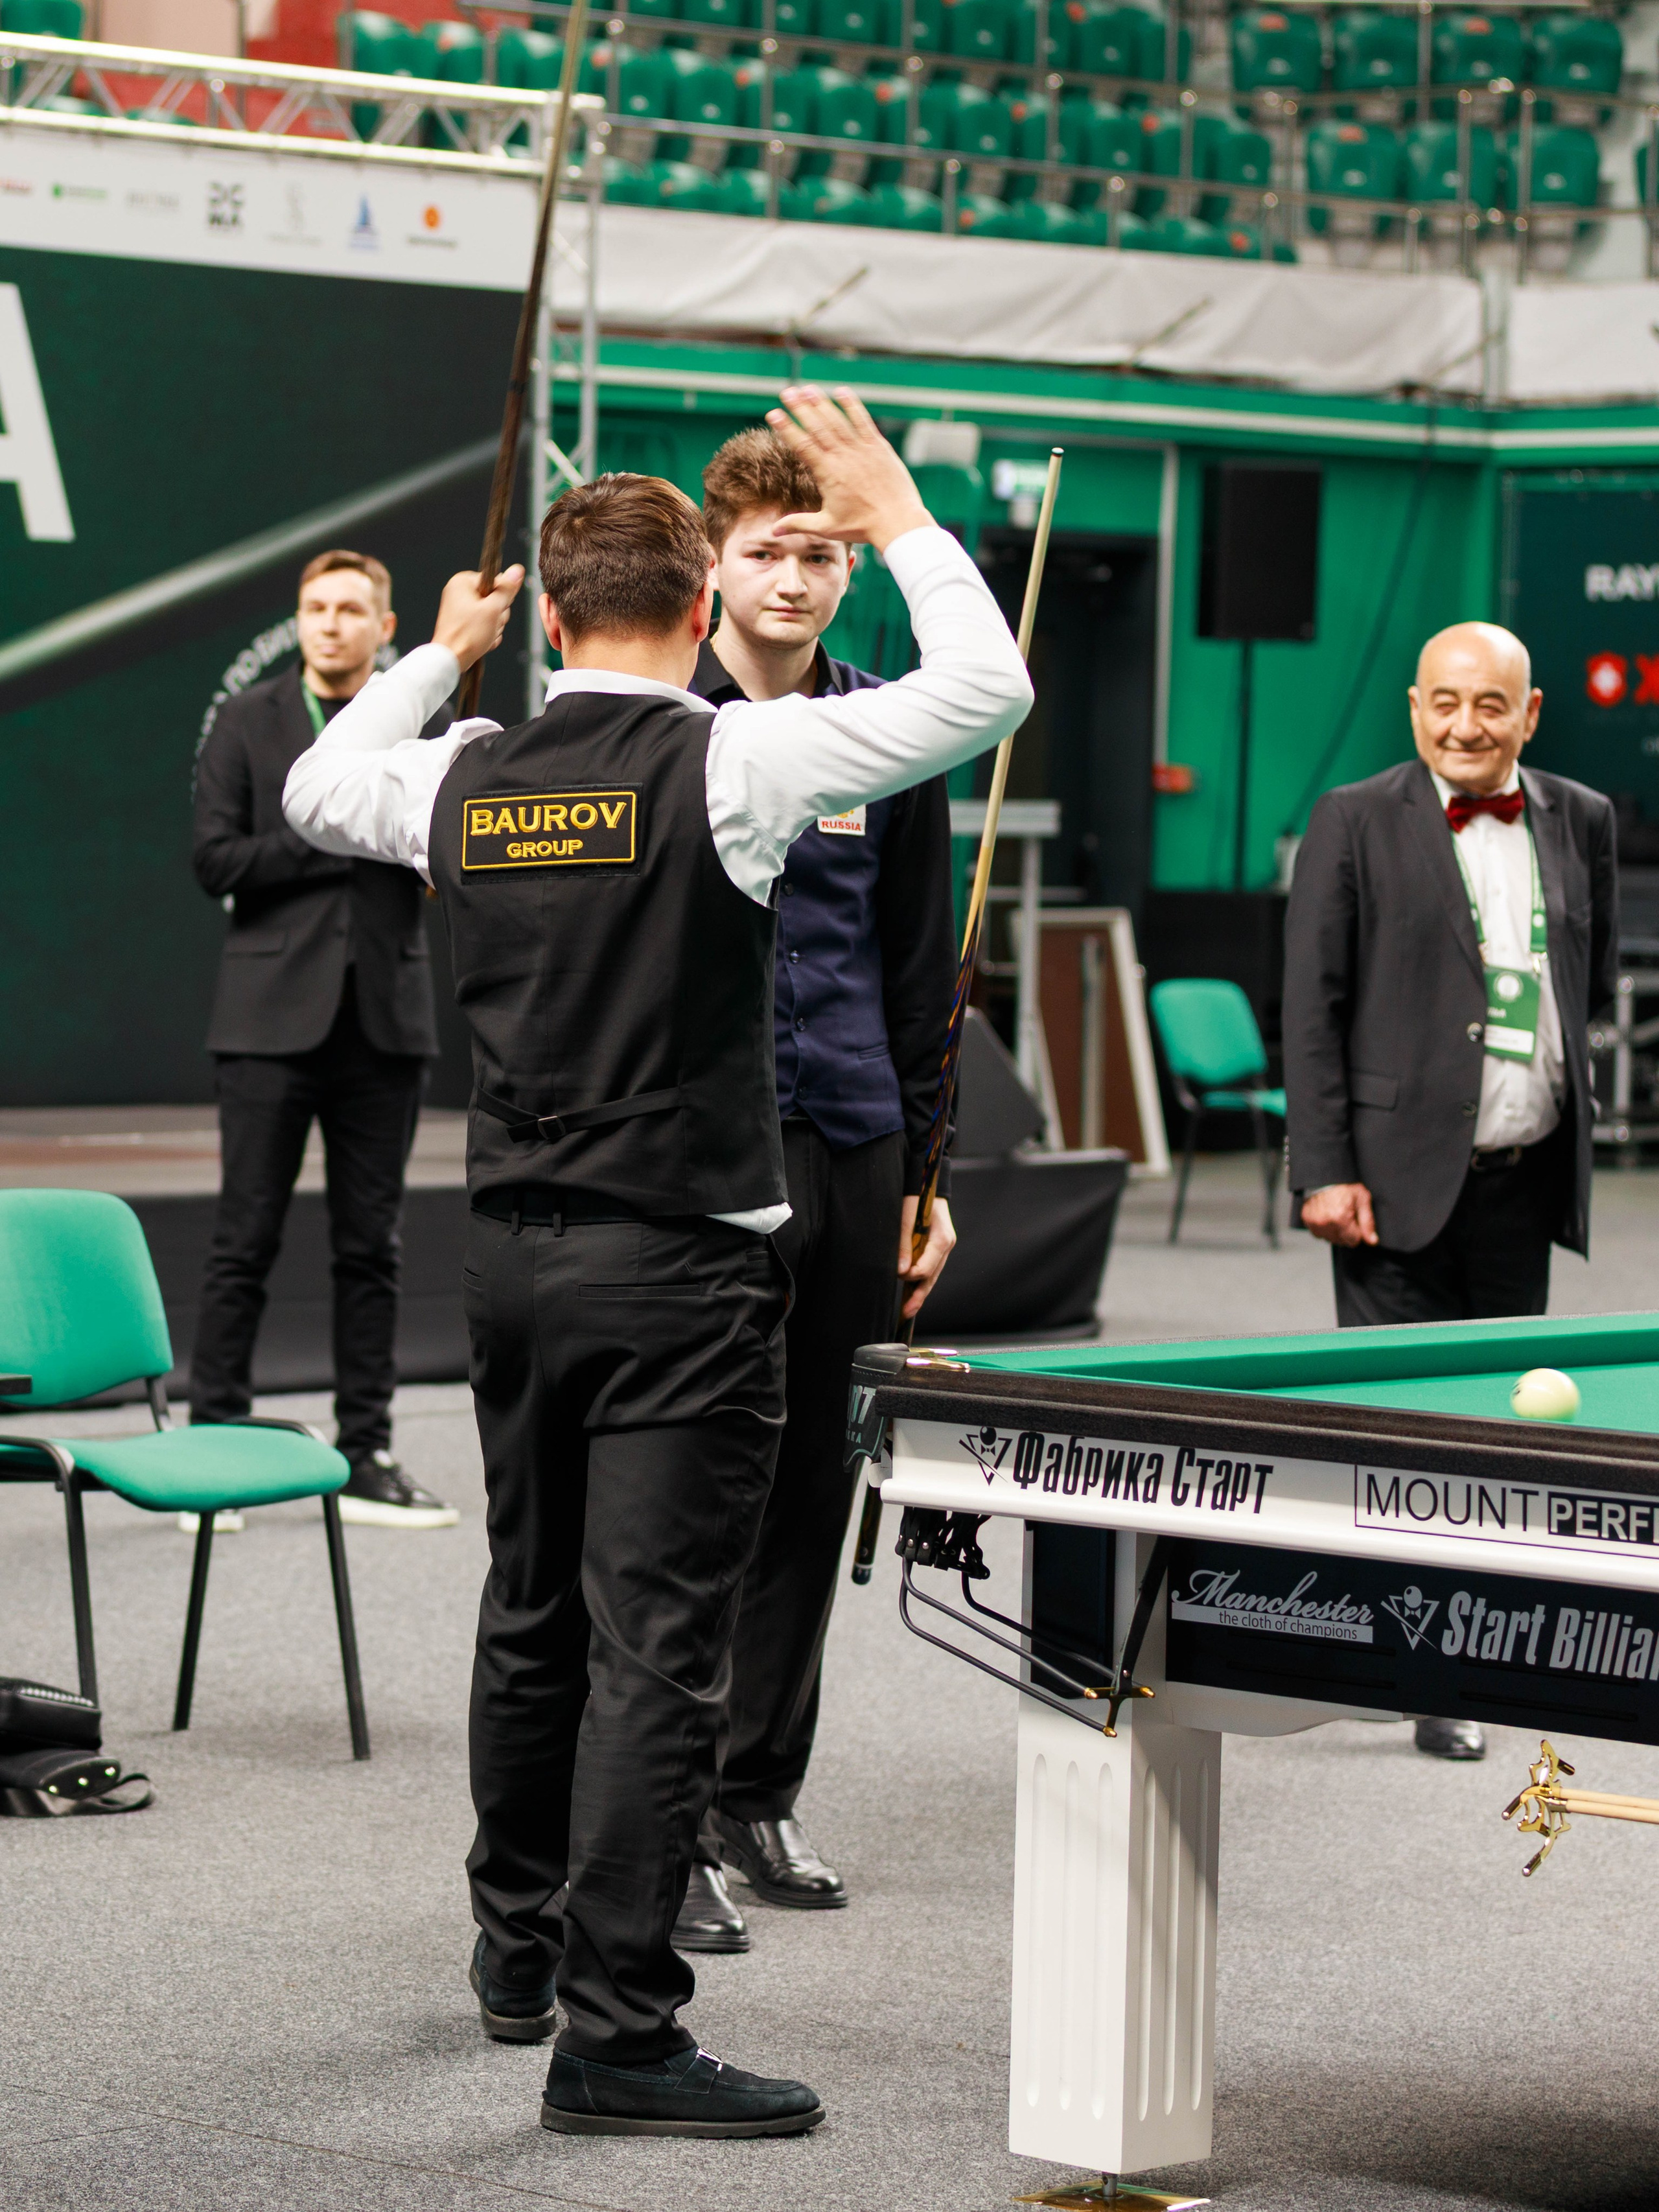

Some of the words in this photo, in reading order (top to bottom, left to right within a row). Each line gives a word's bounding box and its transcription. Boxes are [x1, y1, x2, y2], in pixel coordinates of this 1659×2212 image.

[470, 802, 627, 836] BAUROV
[822, 821, 861, 832] RUSSIA
[506, 839, 583, 858] GROUP
[1013, 1431, 1164, 1503] Фабрика
[1170, 1446, 1274, 1514] Старт
[1366, 1473, 1539, 1532] MOUNT
[1550, 1497, 1659, 1544] PERF
[1171, 1569, 1374, 1624] Manchester
[1219, 1611, 1239, 1625] the
[1242, 1615, 1271, 1630] cloth
[1275, 1620, 1288, 1631] of
[1290, 1620, 1358, 1640] champions
[1441, 1590, 1546, 1665] Start
